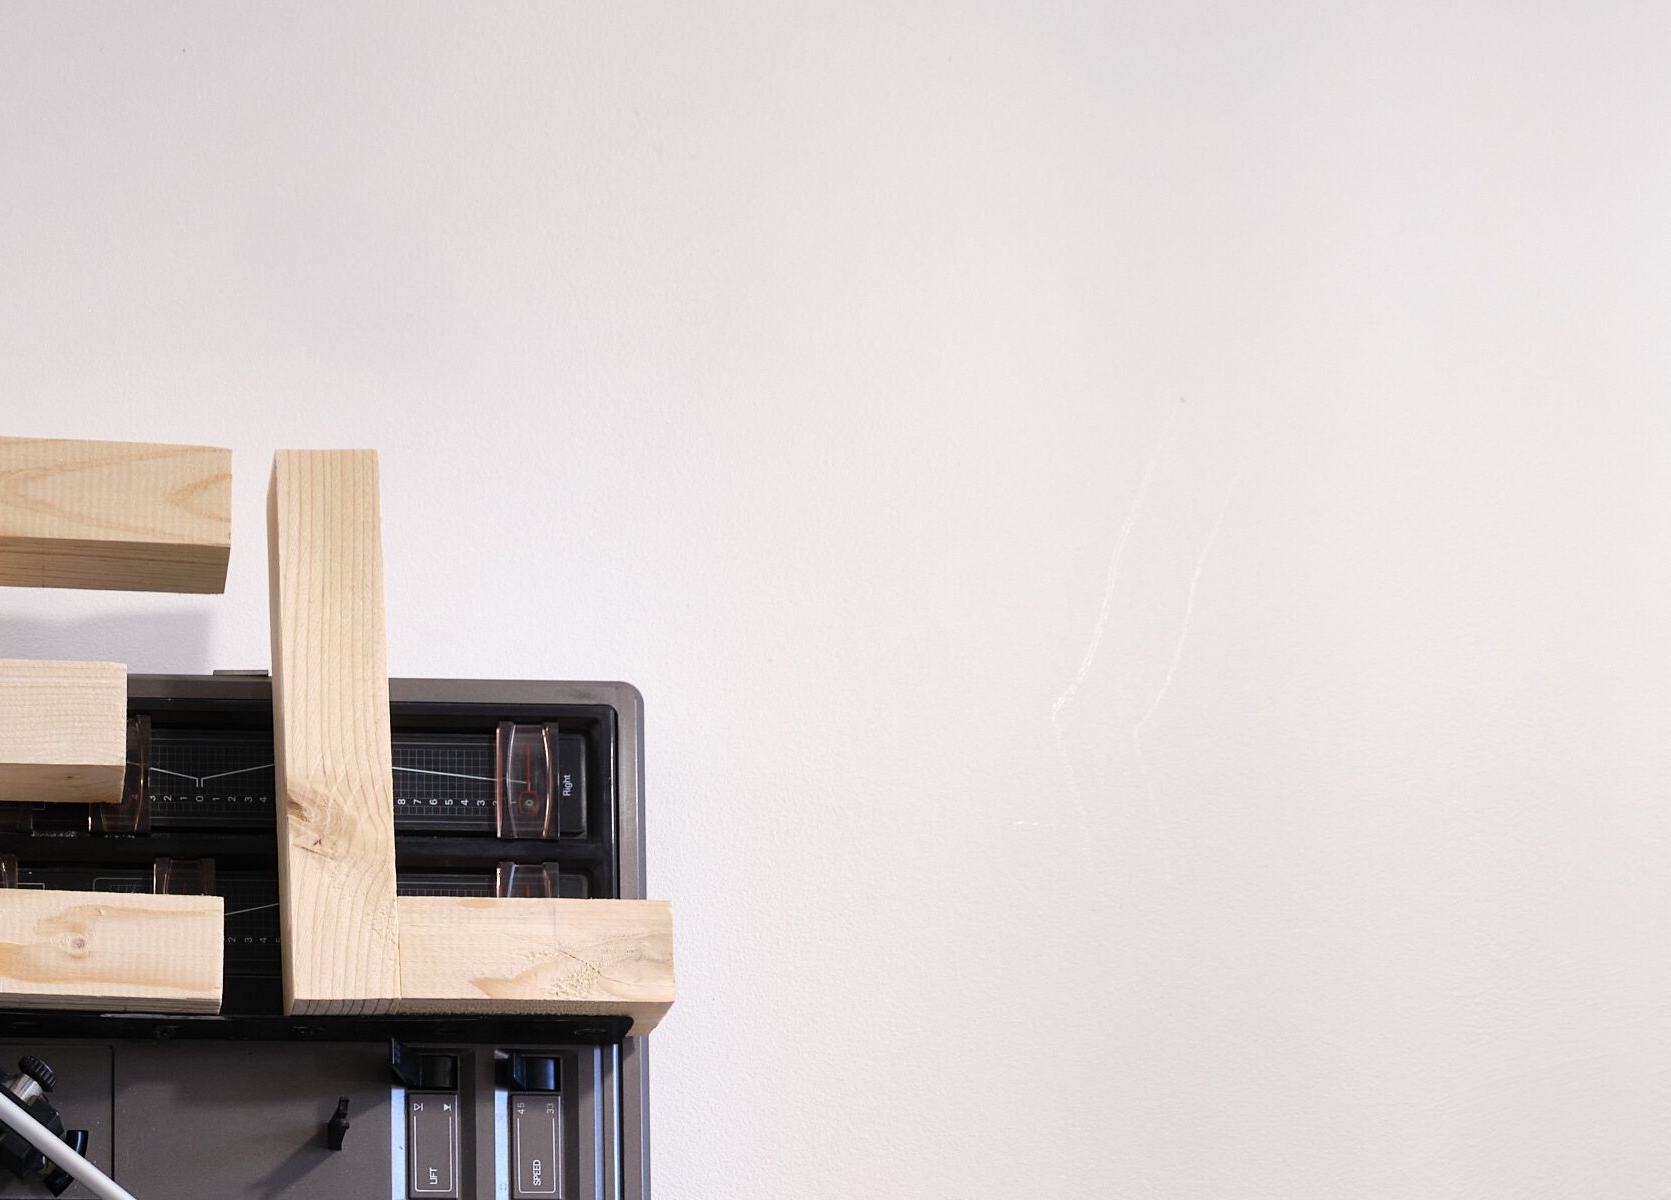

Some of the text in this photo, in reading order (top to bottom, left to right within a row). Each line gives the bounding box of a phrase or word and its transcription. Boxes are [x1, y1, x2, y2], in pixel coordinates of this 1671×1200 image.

[562, 774, 574, 797] Right
[429, 798, 438, 806] 6
[476, 799, 486, 807] 3
[517, 1102, 525, 1115] 45
[546, 1102, 555, 1114] 33
[429, 1166, 439, 1185] LIFT
[532, 1159, 542, 1186] SPEED
